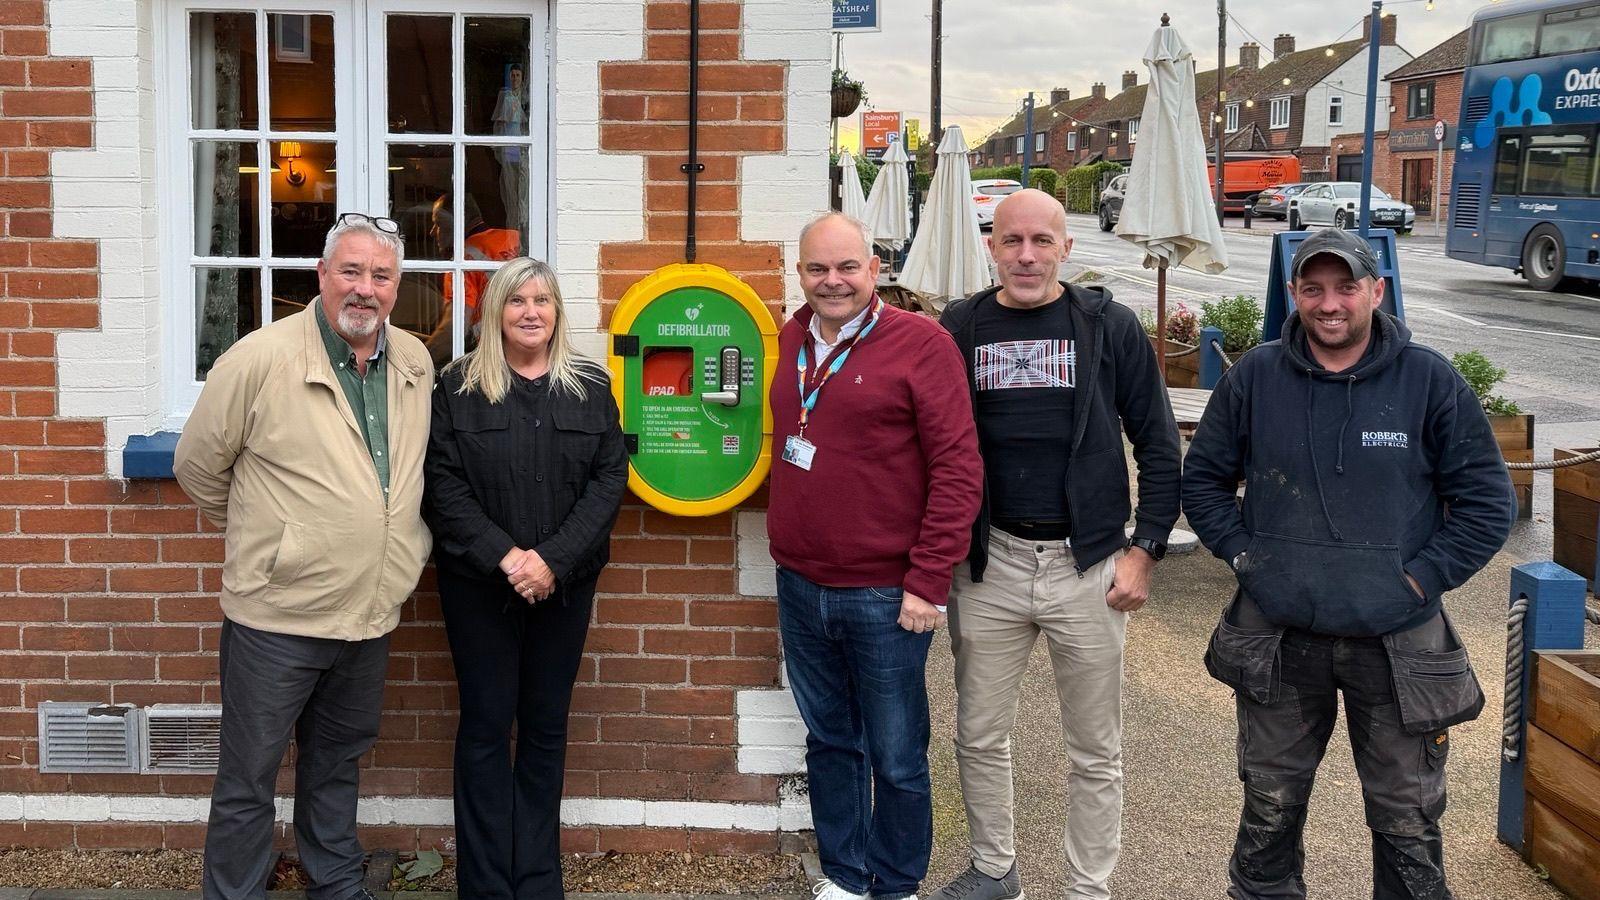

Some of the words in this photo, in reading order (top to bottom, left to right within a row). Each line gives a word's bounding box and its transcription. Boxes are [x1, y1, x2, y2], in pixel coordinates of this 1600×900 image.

[864, 113, 898, 122] Sainsbury's
[658, 324, 731, 337] DEFIBRILLATOR
[649, 386, 675, 396] IPAD
[1361, 431, 1408, 442] ROBERTS
[1362, 441, 1408, 449] ELECTRICAL
